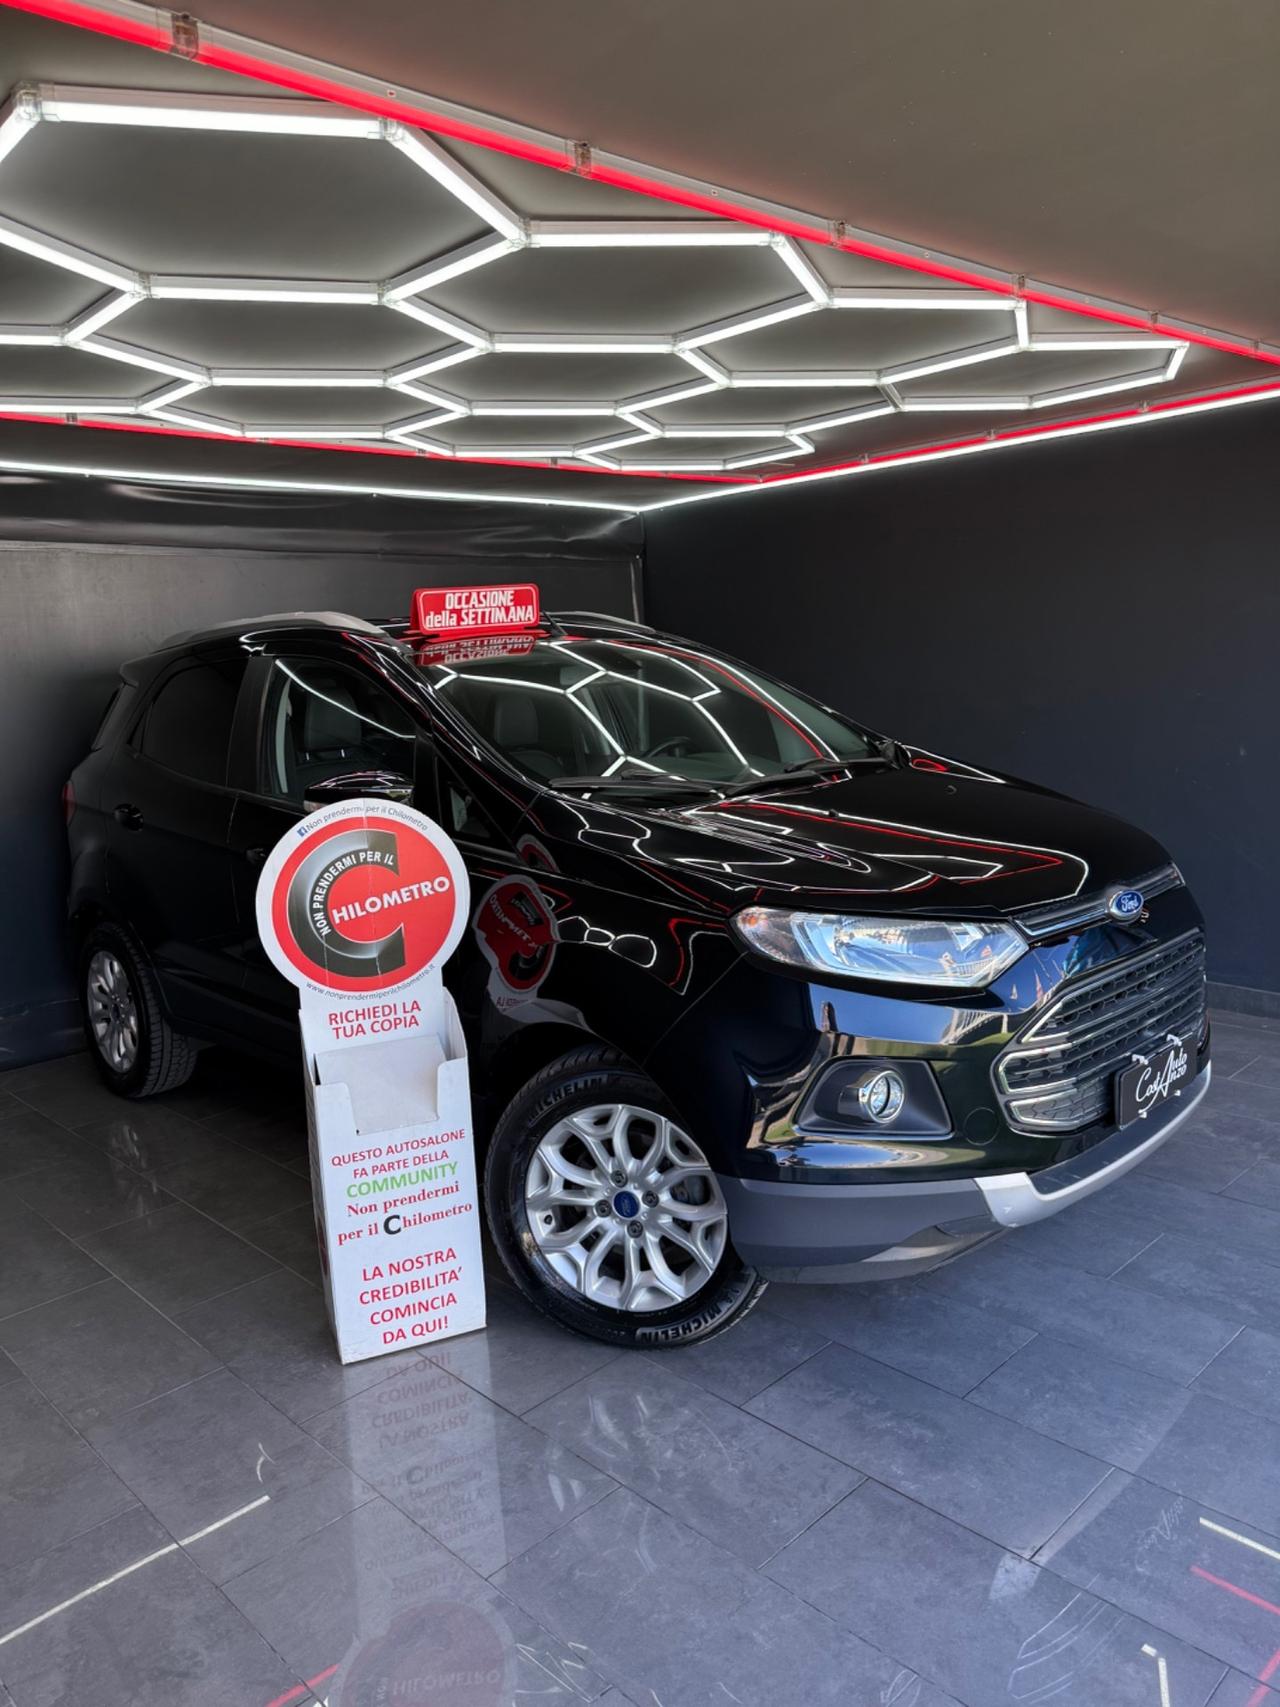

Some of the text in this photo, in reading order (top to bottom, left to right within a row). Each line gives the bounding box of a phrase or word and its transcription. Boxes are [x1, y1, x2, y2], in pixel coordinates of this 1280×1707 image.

[425, 605, 534, 628] della SETTIMANA
[445, 590, 515, 610] OCCASIONE
[306, 817, 323, 832] Non
[366, 805, 380, 813] per
[387, 807, 429, 832] Chilometro
[312, 850, 394, 937] NON PRENDERMI PER IL
[1120, 893, 1139, 912] Ford
[306, 963, 436, 1001] wwwnonprendermiperilchilometro.it
[328, 1000, 422, 1026] RICHIEDI LA
[332, 1015, 419, 1039] TUA COPIA
[528, 1076, 604, 1123] ICHELIN
[331, 1129, 466, 1167] QUESTO AUTOSALONE
[353, 1150, 449, 1179] FA PARTE DELLA
[346, 1161, 459, 1198] COMMUNITY
[347, 1180, 460, 1217] Non prendermi
[338, 1203, 473, 1245] per il Chilometro
[362, 1247, 457, 1281] LA NOSTRA
[359, 1266, 462, 1305] CREDIBILITA'
[370, 1292, 457, 1325] COMINCIA
[640, 1303, 722, 1343] MICHELIN
[383, 1316, 449, 1344] DA QUI!
